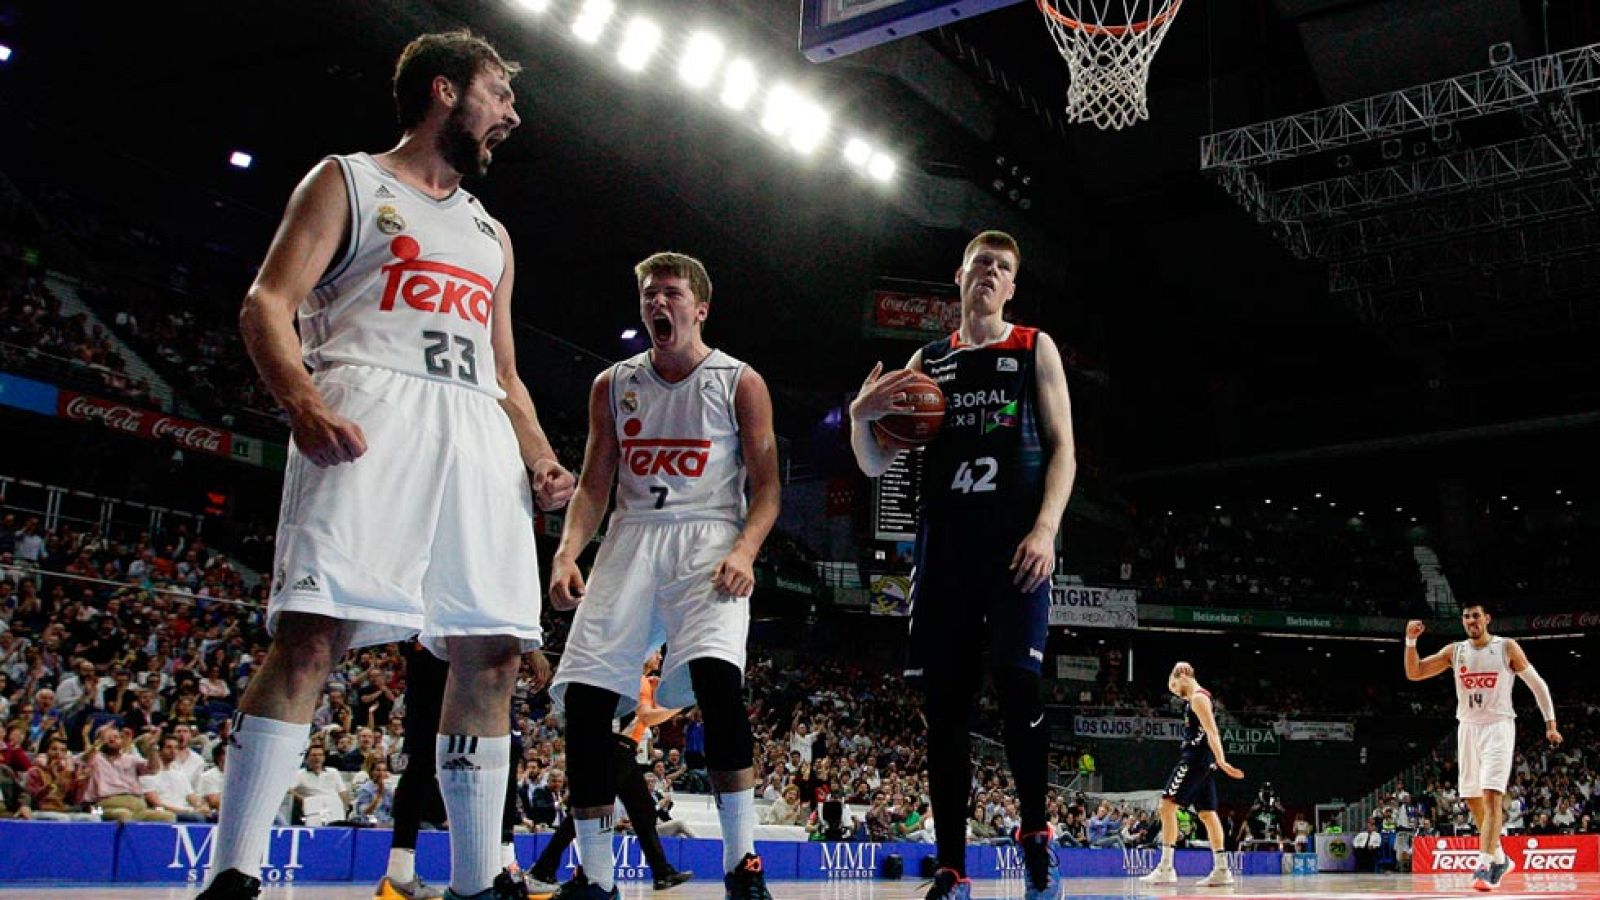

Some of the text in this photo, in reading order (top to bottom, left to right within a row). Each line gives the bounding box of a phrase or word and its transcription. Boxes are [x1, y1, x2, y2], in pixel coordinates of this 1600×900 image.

[423, 330, 478, 385] 23
[946, 388, 1010, 408] BORAL
[951, 456, 998, 493] 42
[650, 486, 668, 509] 7
[1051, 588, 1103, 607] TIGRE
[1469, 693, 1482, 708] 14
[1076, 720, 1098, 733] LOS
[1101, 721, 1131, 734] OJOS
[1145, 722, 1166, 736] DEL
[1222, 728, 1275, 743] ALIDA
[1229, 743, 1257, 754] EXIT
[168, 825, 315, 868] MT
[820, 842, 882, 869] MMT
[1122, 847, 1156, 868] MMT
